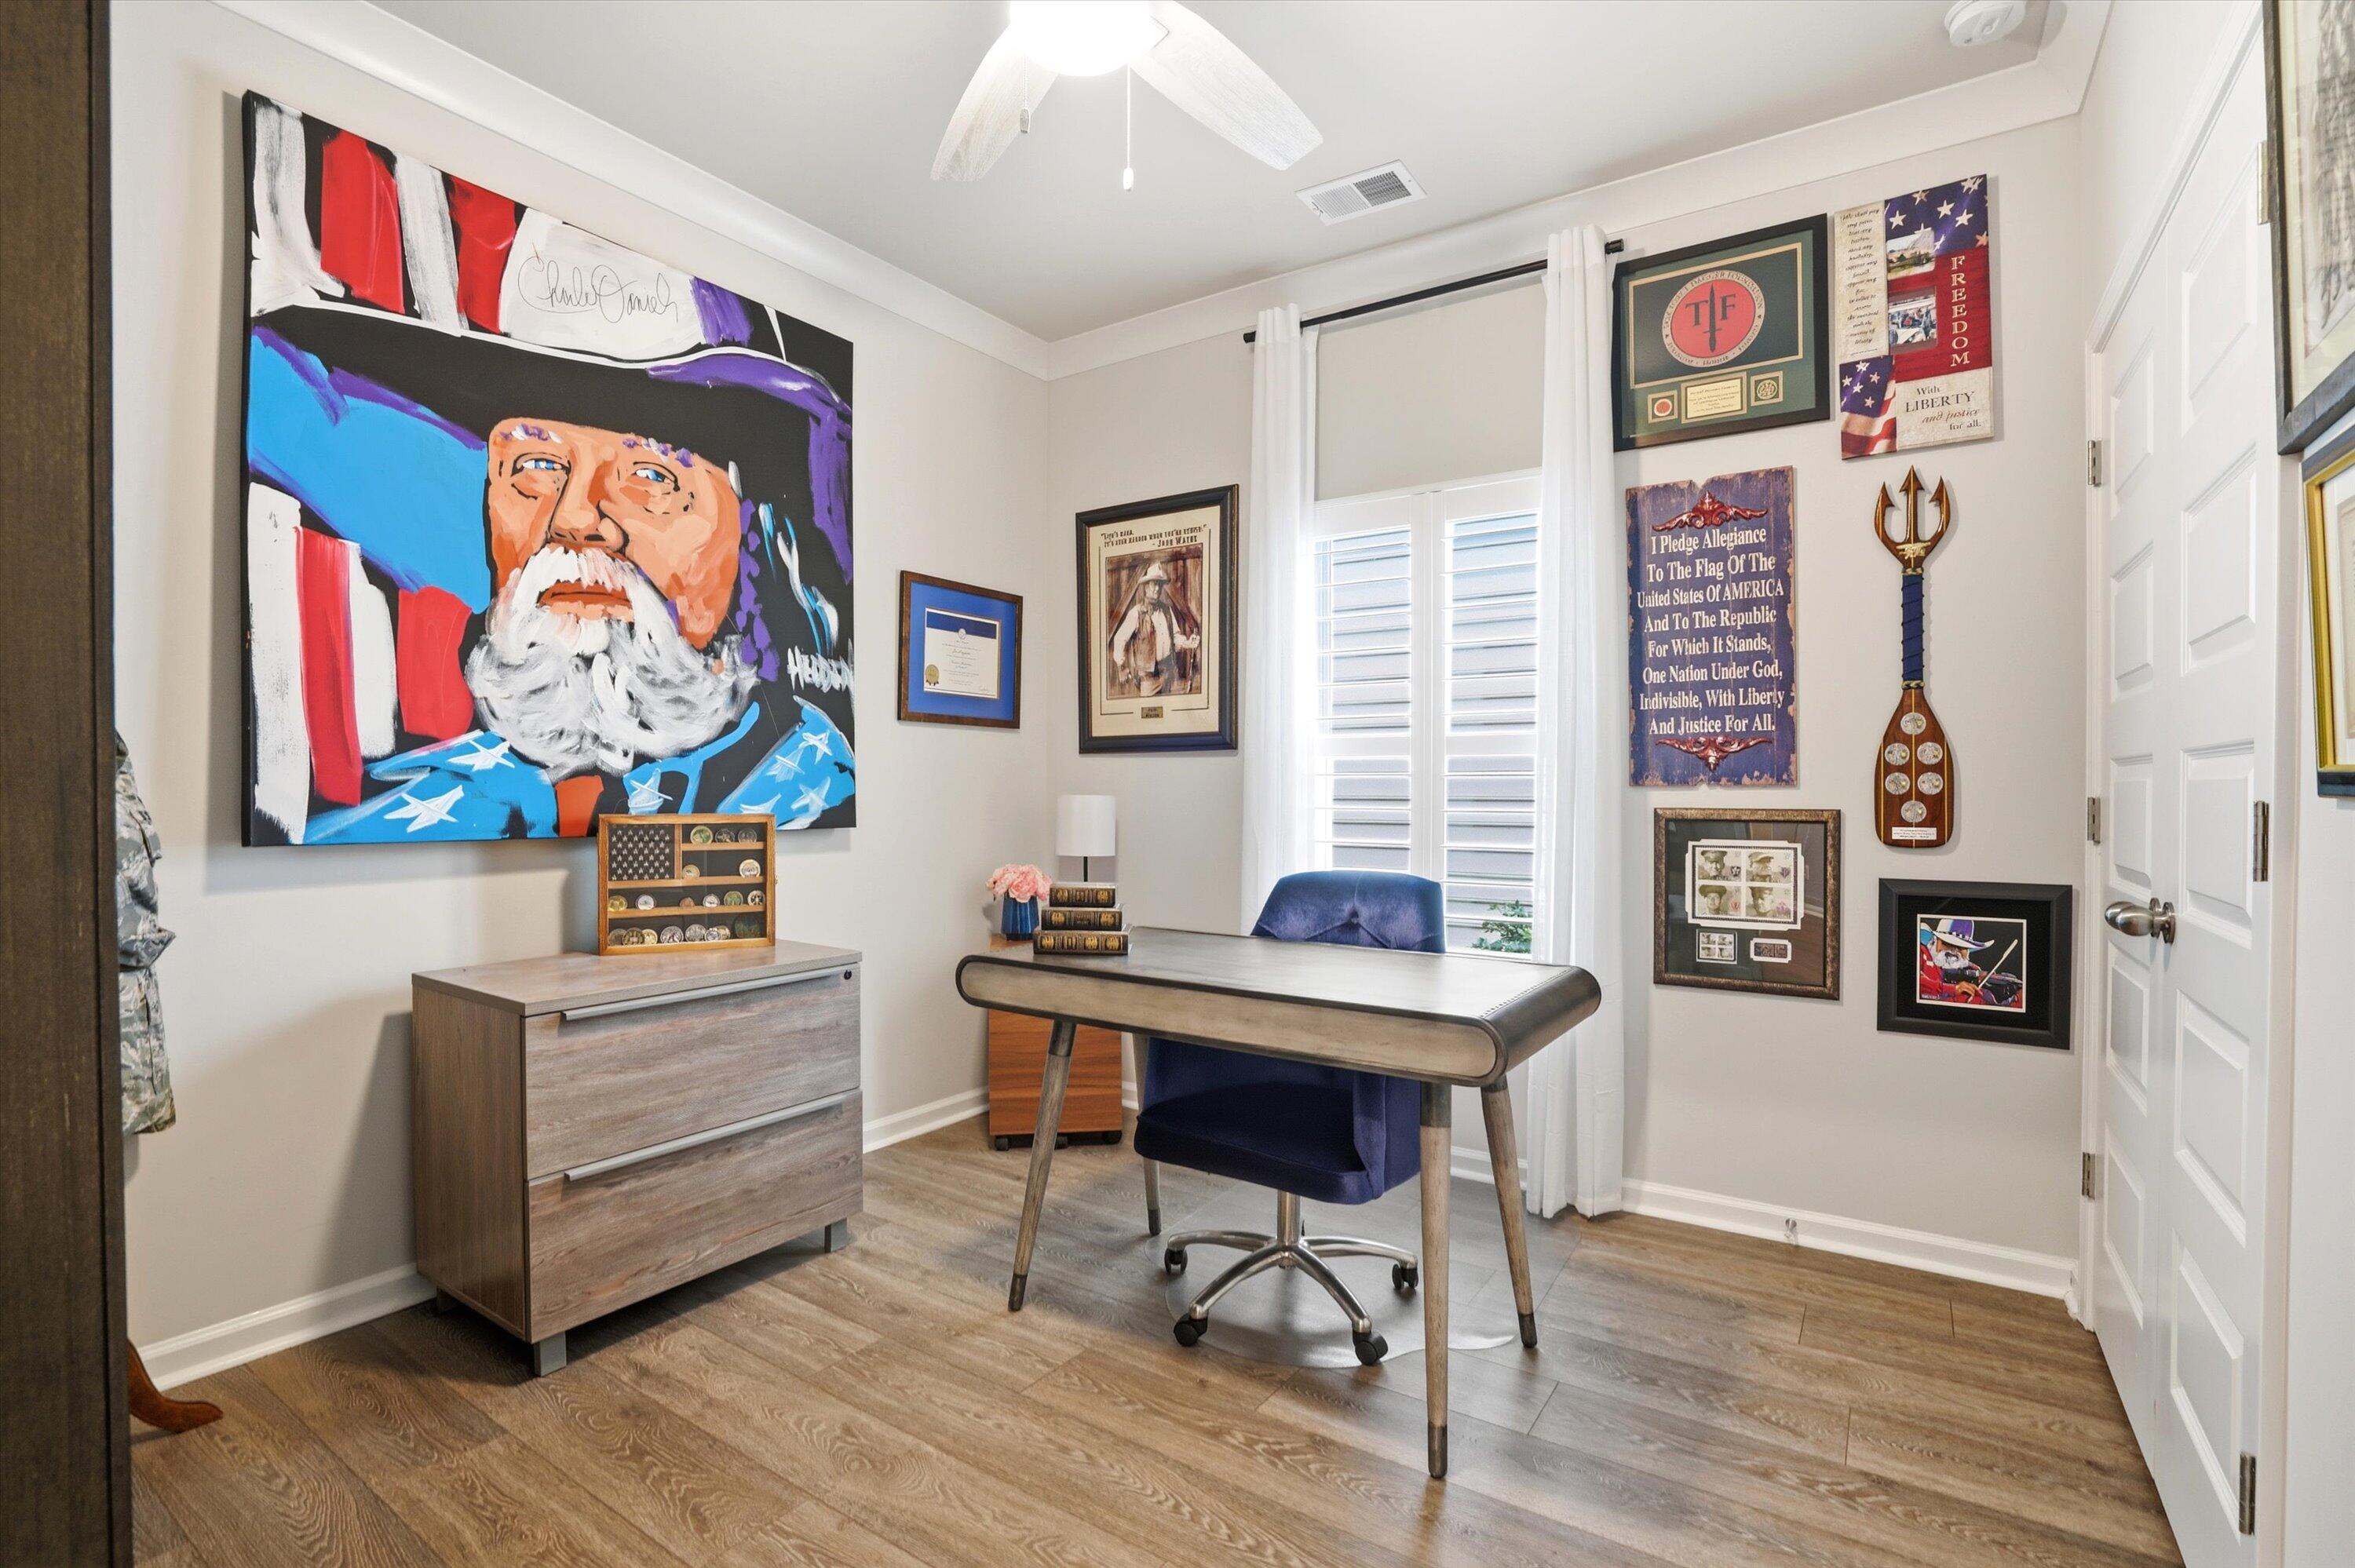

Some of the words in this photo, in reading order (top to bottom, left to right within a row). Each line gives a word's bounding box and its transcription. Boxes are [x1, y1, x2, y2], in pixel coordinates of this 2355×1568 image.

[1685, 300, 1709, 326] T
[1721, 294, 1736, 321] F
[1950, 255, 1970, 367] FREEDOM
[1905, 391, 1975, 413] LIBERTY
[1916, 385, 1941, 396] With
[1922, 408, 1945, 424] and
[1945, 408, 1981, 424] justice
[1949, 420, 1963, 431] for
[1966, 419, 1982, 428] all.
[1651, 536, 1658, 555] I
[1660, 534, 1700, 556] Pledge
[1702, 526, 1767, 550] Allegiance
[1647, 563, 1663, 582] To
[1667, 561, 1692, 580] The
[1695, 558, 1724, 579] Flag
[1728, 554, 1745, 574] Of
[1748, 552, 1776, 571] The
[1637, 590, 1670, 608] United
[1673, 588, 1704, 605] States
[1706, 585, 1722, 603] Of
[1723, 578, 1784, 601] AMERICA
[1645, 615, 1669, 633] And
[1673, 613, 1689, 631] To
[1692, 611, 1717, 629] The
[1719, 605, 1777, 630] Republic
[1648, 640, 1669, 658] For
[1671, 637, 1710, 656] Which
[1713, 636, 1723, 654] It
[1726, 633, 1772, 654] Stands,
[1643, 667, 1666, 684] One
[1669, 665, 1708, 682] Nation
[1711, 662, 1750, 680] Under
[1752, 659, 1783, 680] God,
[1640, 691, 1703, 710] Indivisible,
[1705, 689, 1736, 707] With
[1739, 687, 1785, 709] Liberty
[1649, 717, 1674, 735] And
[1678, 715, 1722, 735] Justice
[1725, 715, 1749, 731] For
[1752, 713, 1776, 731] All.
